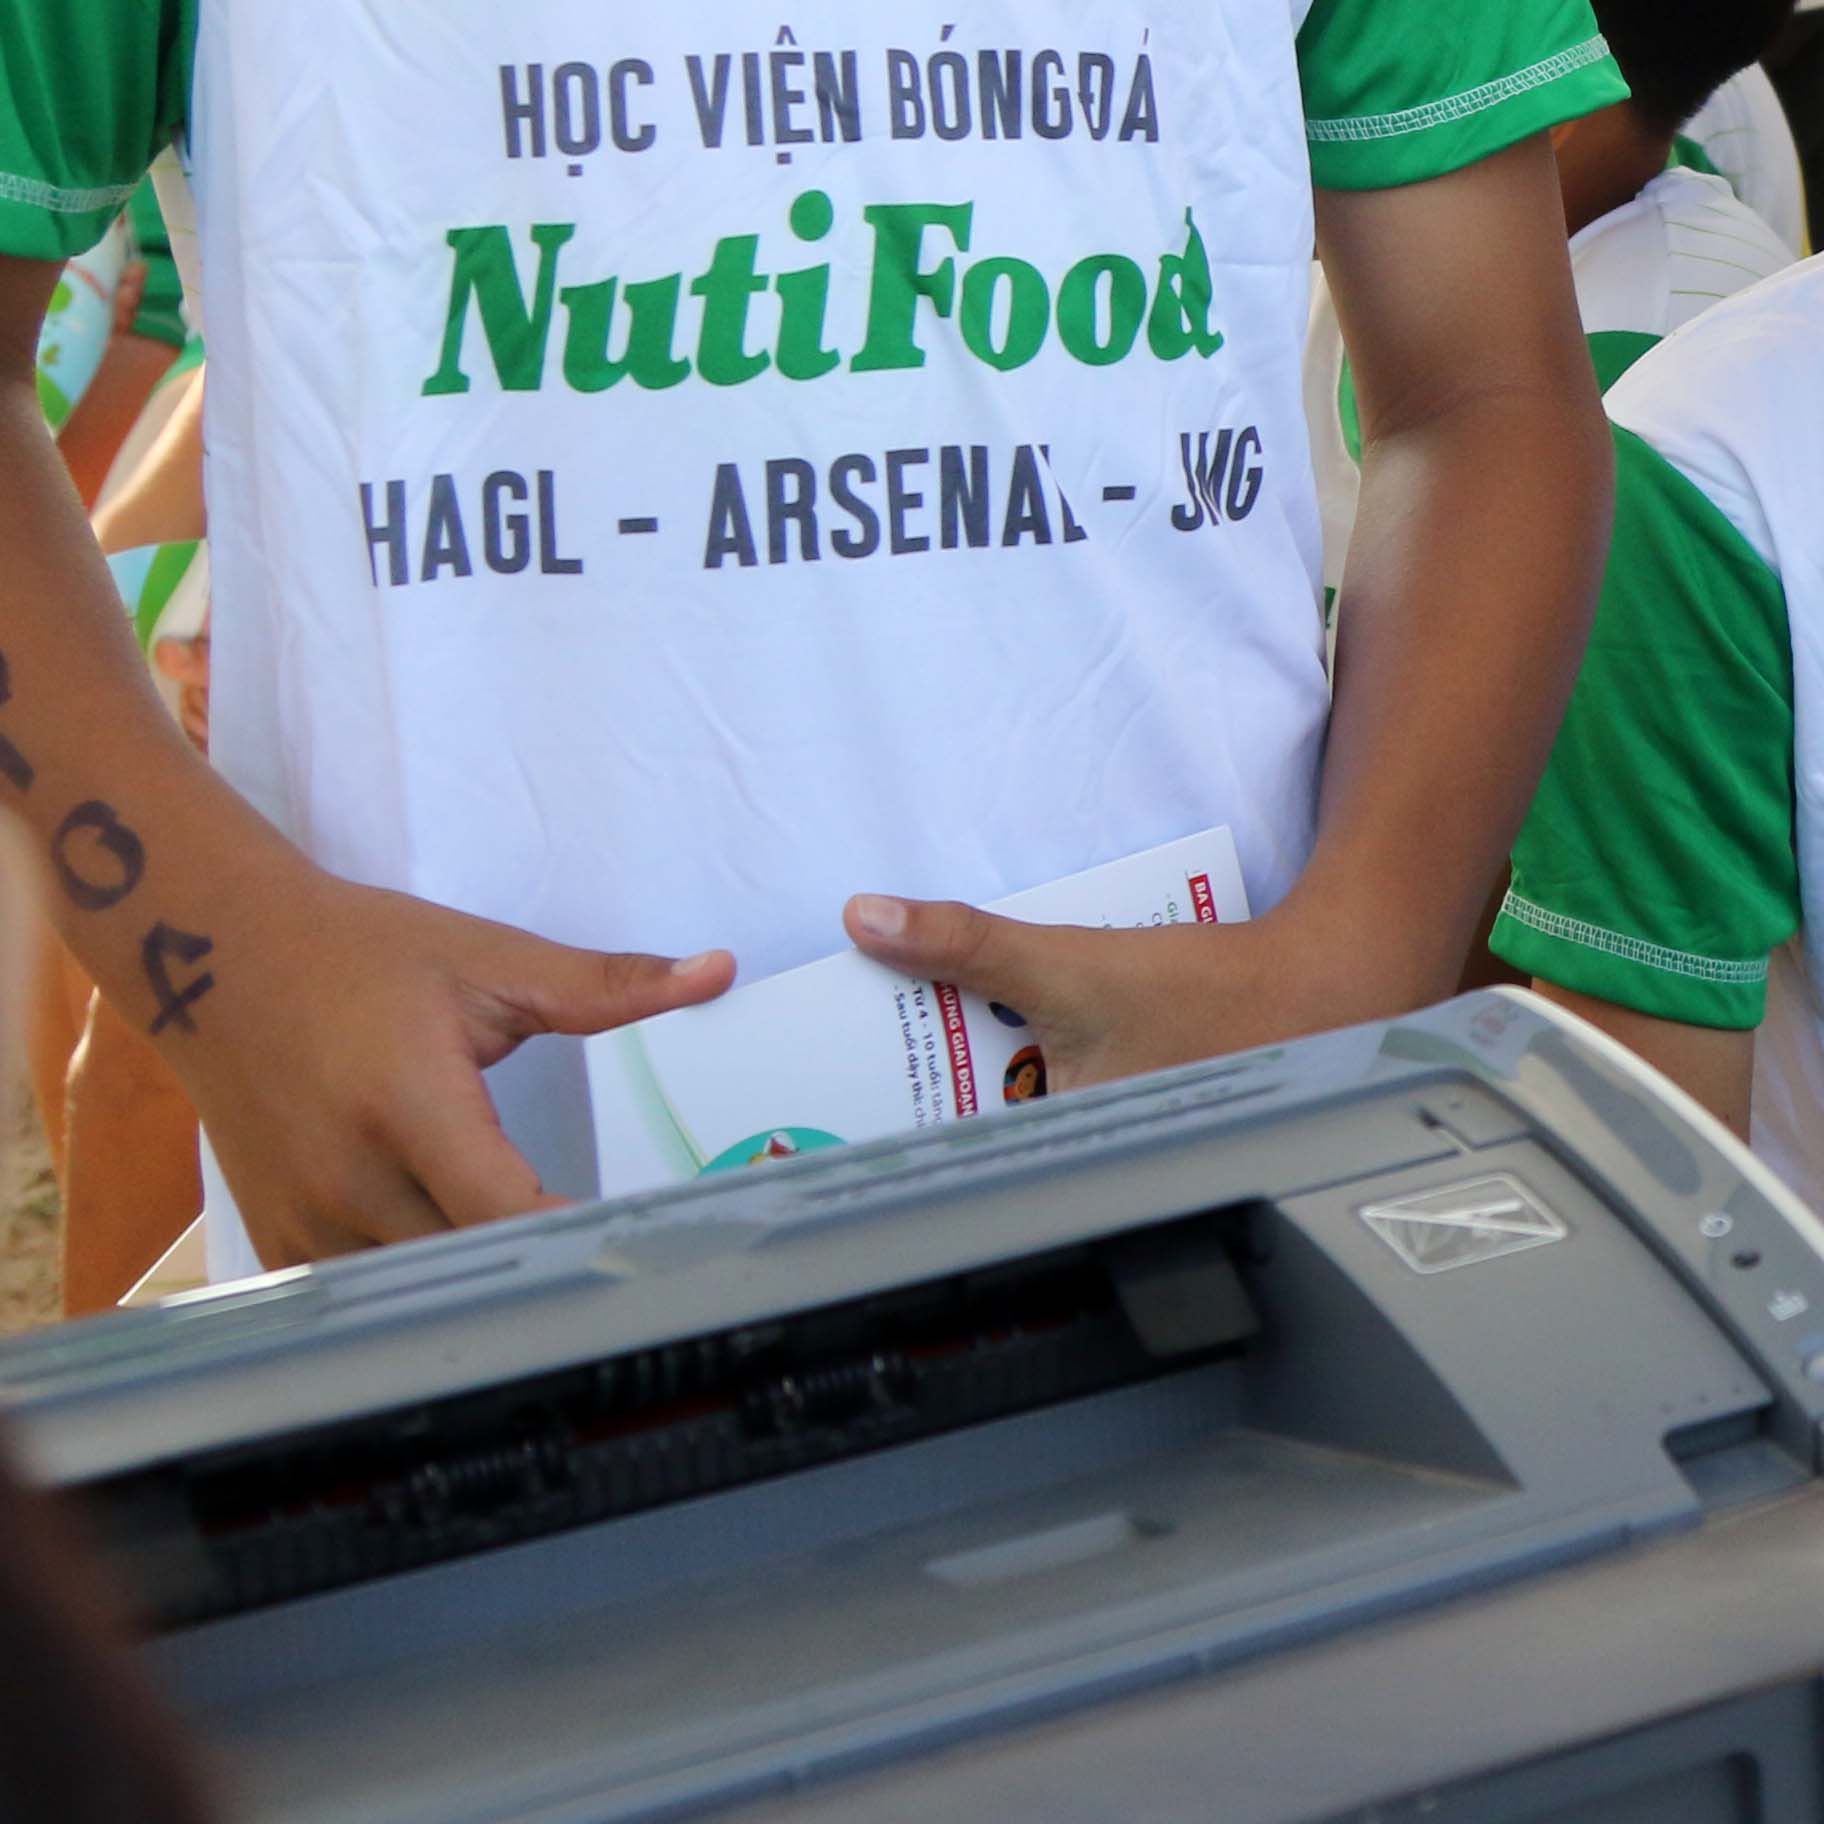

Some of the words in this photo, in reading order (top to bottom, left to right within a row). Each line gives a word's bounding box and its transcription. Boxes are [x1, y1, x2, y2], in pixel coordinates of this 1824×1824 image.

[498, 59, 657, 176] HỌC
[684, 26, 860, 165] VIỆN
[422, 188, 1224, 397] NutiFood
[359, 469, 583, 587] HAGL
[895, 992, 907, 1020] Sau
[952, 1033, 969, 1067] GIAI
[957, 1069, 975, 1118] ĐOẠN
